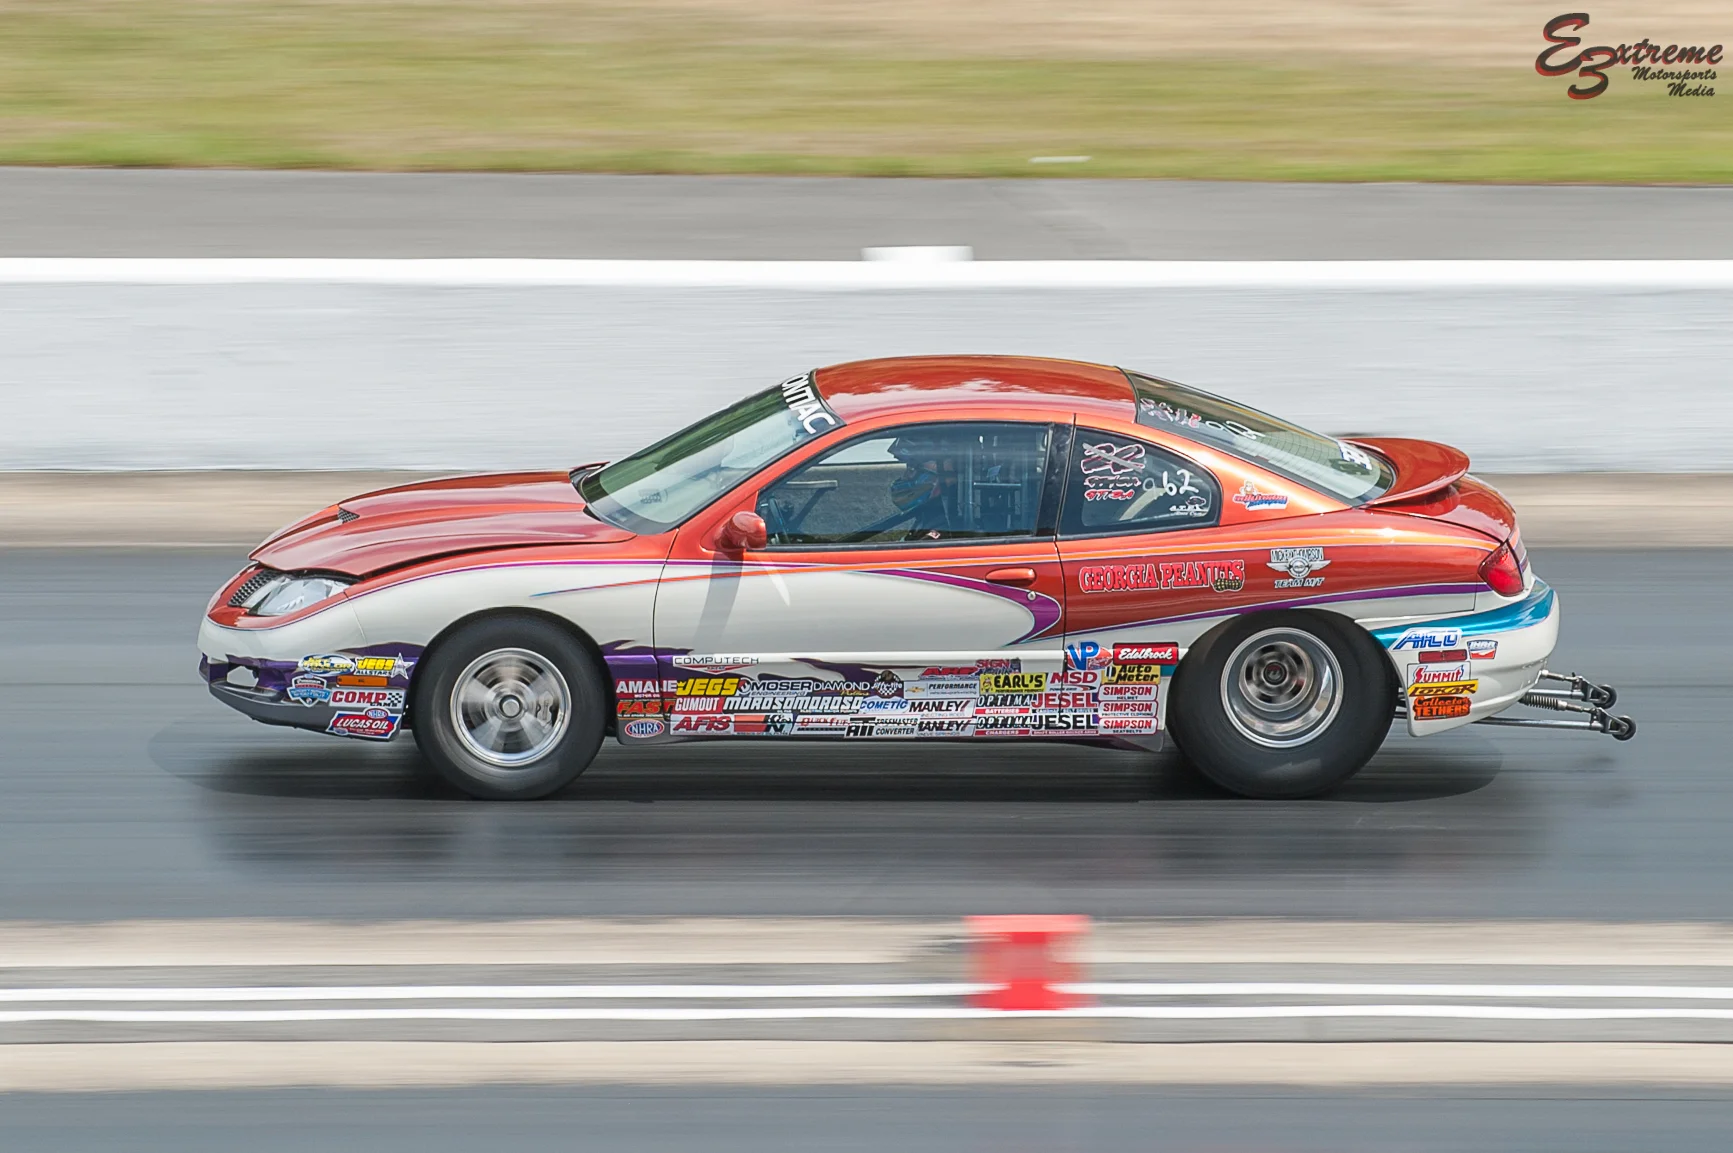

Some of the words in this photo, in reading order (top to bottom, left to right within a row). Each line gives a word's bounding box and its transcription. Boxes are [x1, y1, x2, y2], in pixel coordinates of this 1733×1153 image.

[1080, 563, 1159, 592] GEORGIA
[1160, 560, 1244, 589] PEANUTS
[1067, 641, 1100, 670] VP
[1118, 647, 1173, 660] Edelbrock
[357, 658, 395, 671] JEGS
[674, 656, 760, 665] COMPUTECH
[994, 675, 1043, 688] EARL'S
[1050, 671, 1098, 684] MSD
[676, 678, 739, 696] JEGS
[751, 681, 812, 691] MOSER
[813, 681, 871, 691] DIAMOND
[1102, 686, 1153, 696] SIMPSON
[331, 691, 388, 703] COMP
[723, 696, 794, 710] MOROSO
[792, 696, 864, 710] MOROSO
[977, 695, 1031, 707] OPTIMA
[1031, 692, 1098, 708] JESEL
[617, 701, 676, 714] FAST
[675, 697, 720, 711] GUMOUT
[860, 699, 908, 710] COMETIC
[909, 700, 966, 712] MANLEY
[1102, 702, 1153, 712] SIMPSON
[1415, 704, 1470, 717] TETHERS
[336, 718, 372, 728] LUCAS
[371, 720, 389, 729] OIL
[630, 722, 659, 734] NHRA
[977, 717, 1031, 728] OPTIMA
[1031, 714, 1098, 730] JESEL
[1102, 719, 1153, 729] SIMPSON
[875, 727, 915, 735] CONVERTER
